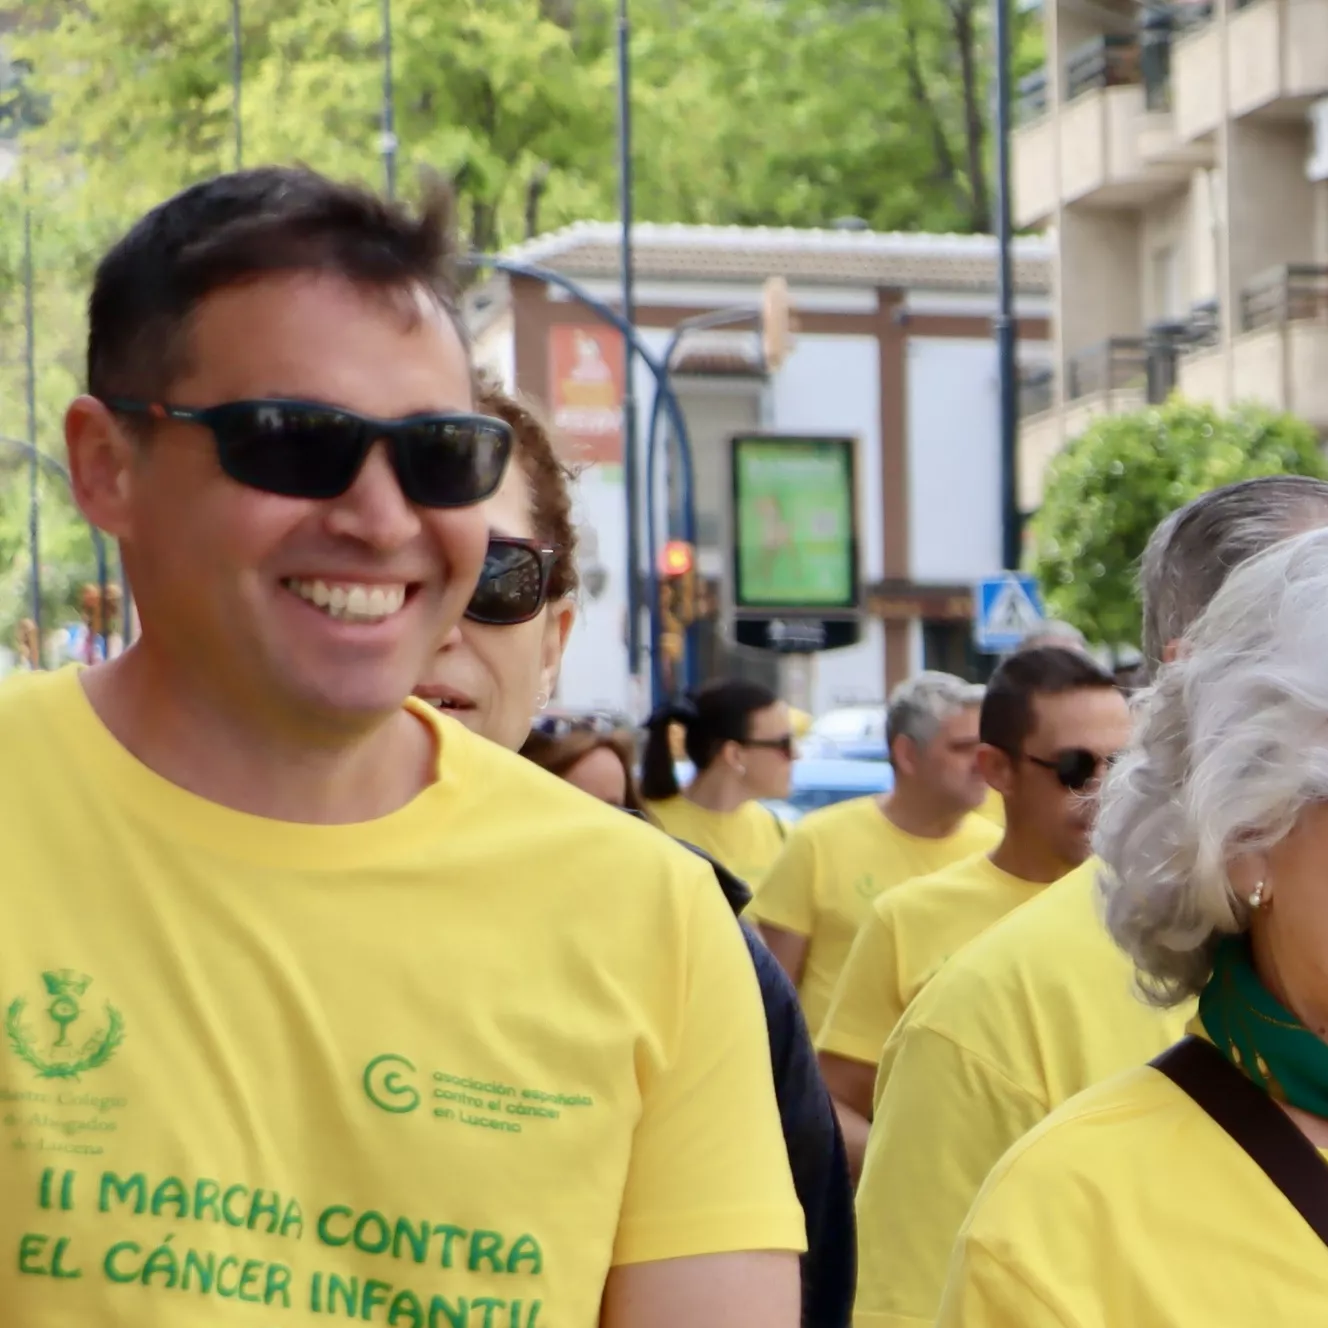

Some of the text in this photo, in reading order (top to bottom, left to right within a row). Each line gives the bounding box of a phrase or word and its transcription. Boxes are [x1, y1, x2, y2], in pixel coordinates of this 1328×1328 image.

[459, 1111, 522, 1134] Lucena
[37, 1167, 543, 1276] II MARCHA CONTRA
[17, 1232, 82, 1279] EL
[103, 1232, 292, 1309] CÁNCER
